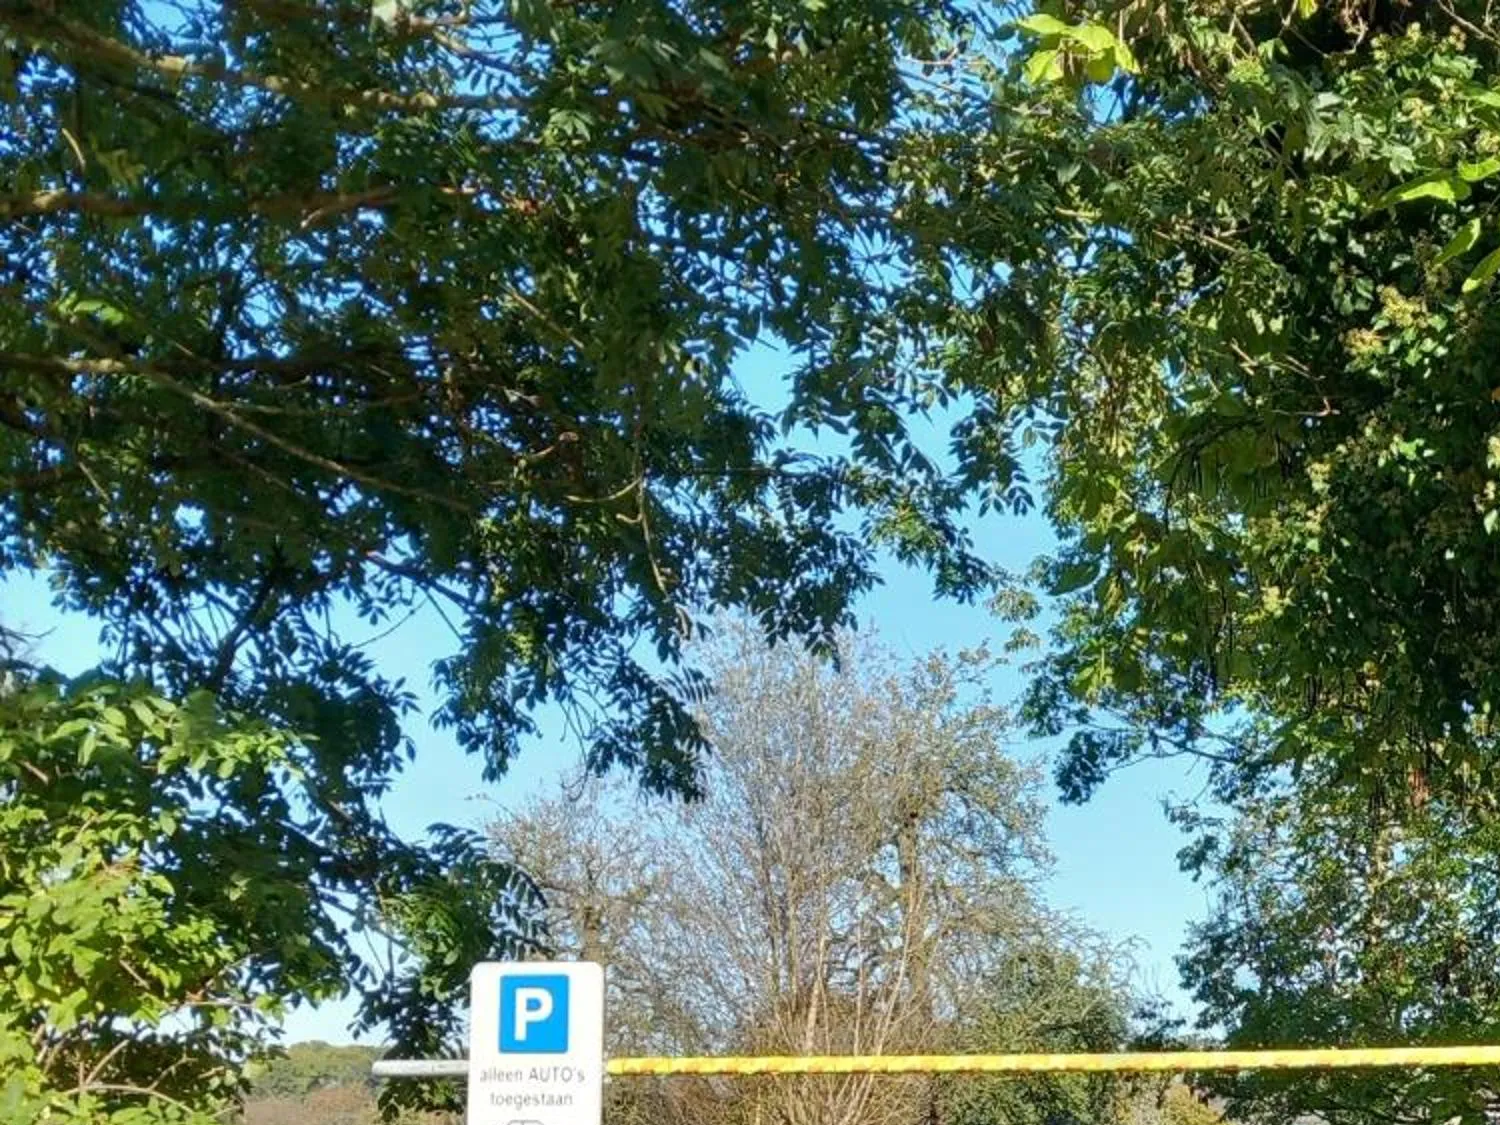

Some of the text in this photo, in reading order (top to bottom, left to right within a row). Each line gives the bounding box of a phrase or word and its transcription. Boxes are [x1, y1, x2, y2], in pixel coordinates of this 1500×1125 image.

[513, 987, 554, 1041] P
[480, 1066, 585, 1084] alleen AUTO's
[490, 1093, 573, 1111] toegestaan
